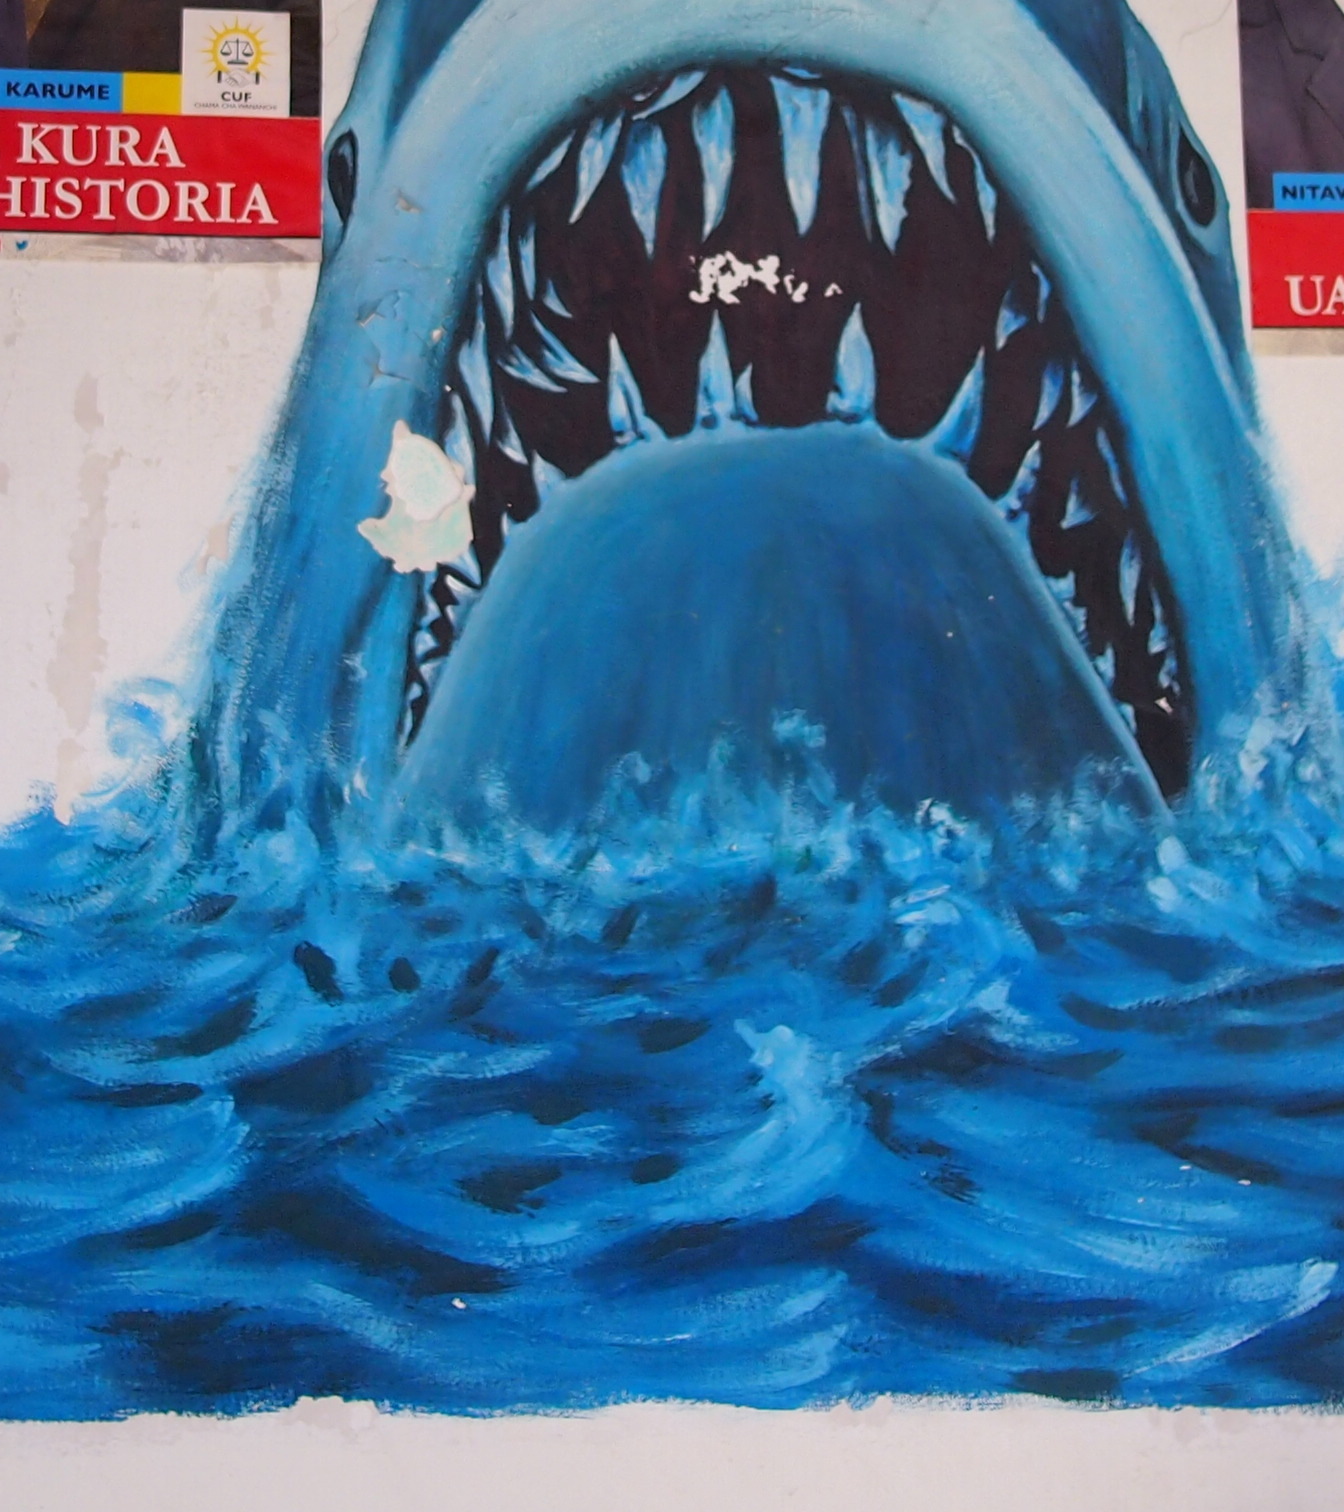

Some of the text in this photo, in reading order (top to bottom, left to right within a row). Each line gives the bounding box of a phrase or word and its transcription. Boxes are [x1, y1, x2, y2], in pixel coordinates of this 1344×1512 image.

[5, 80, 110, 101] KARUME
[221, 91, 252, 102] CUF
[17, 122, 185, 168] KURA
